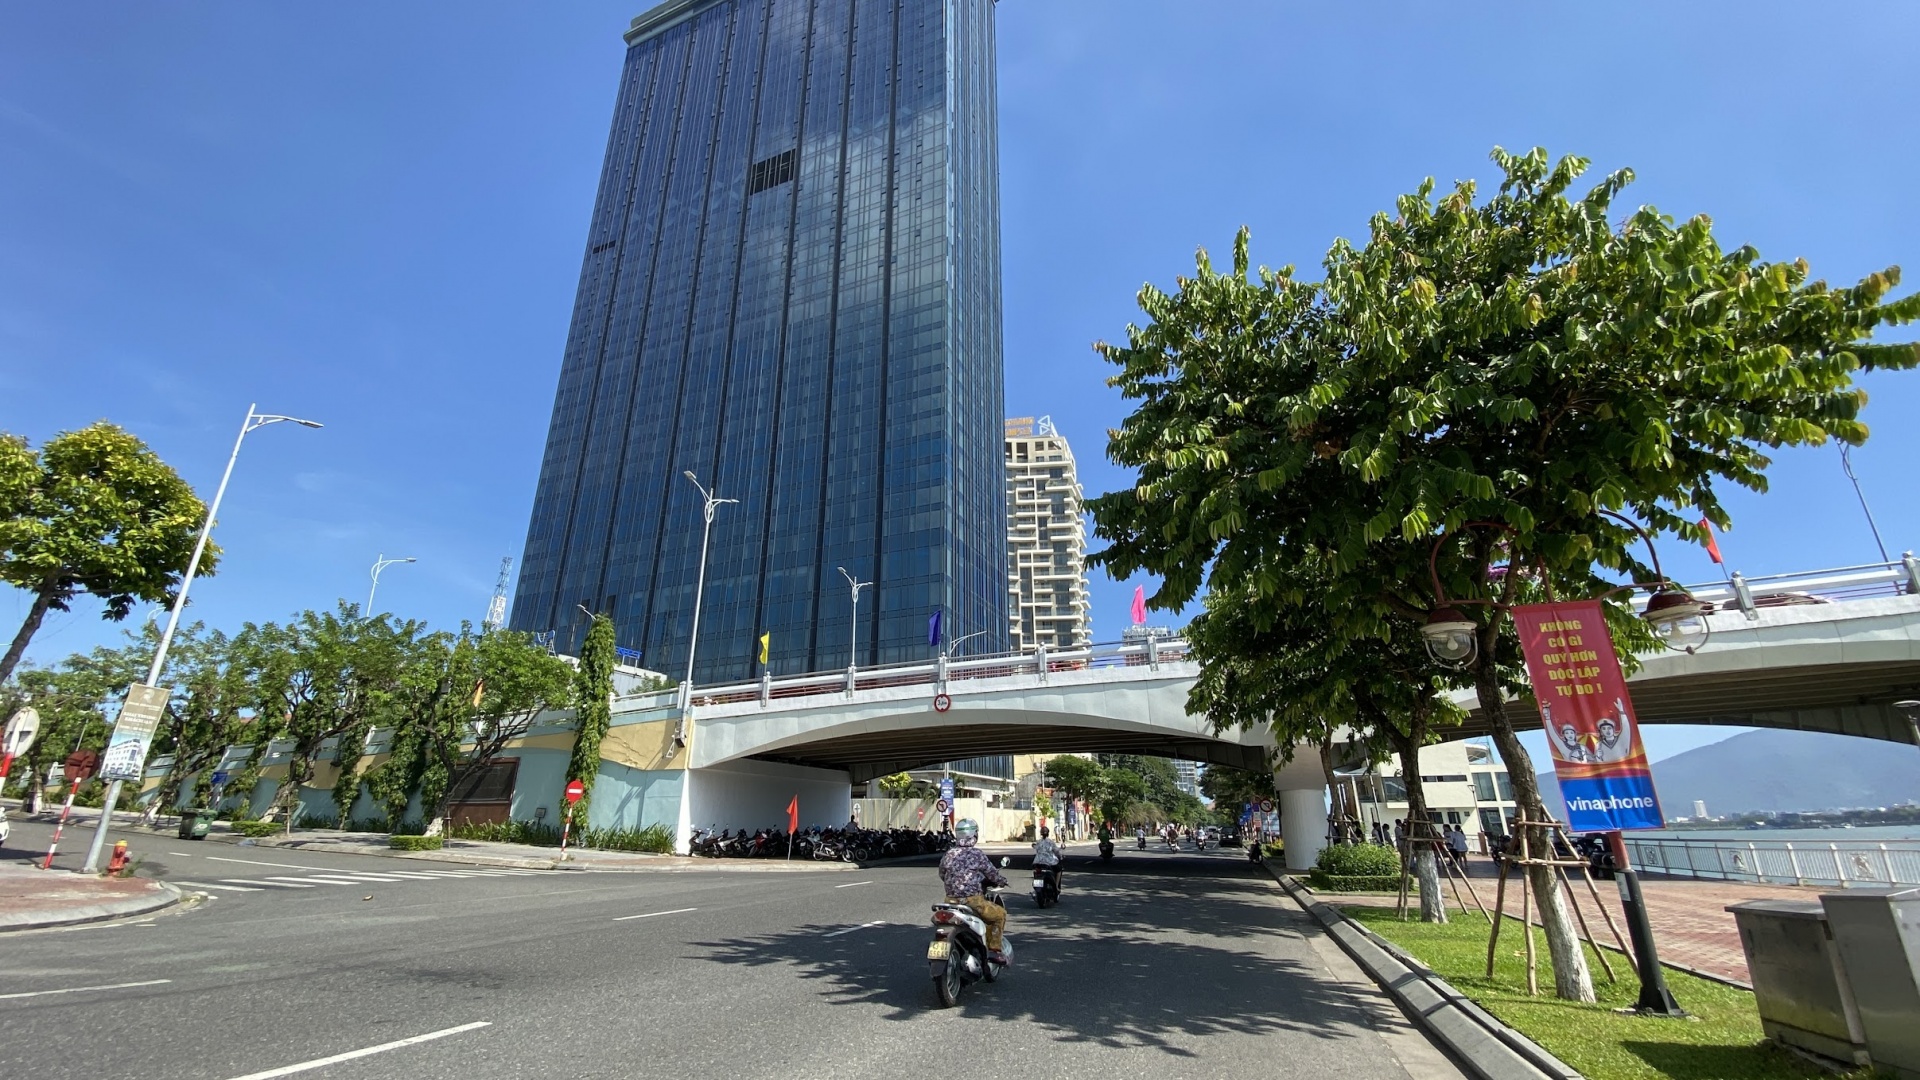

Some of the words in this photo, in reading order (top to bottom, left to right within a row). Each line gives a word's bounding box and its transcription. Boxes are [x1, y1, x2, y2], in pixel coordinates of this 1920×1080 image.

[1543, 651, 1567, 665] QUÝ
[1569, 650, 1598, 662] HƠN
[1576, 665, 1601, 679] LẬP
[1555, 683, 1573, 697] TỰ
[1575, 683, 1594, 695] DO
[1566, 794, 1654, 812] vinaphone
